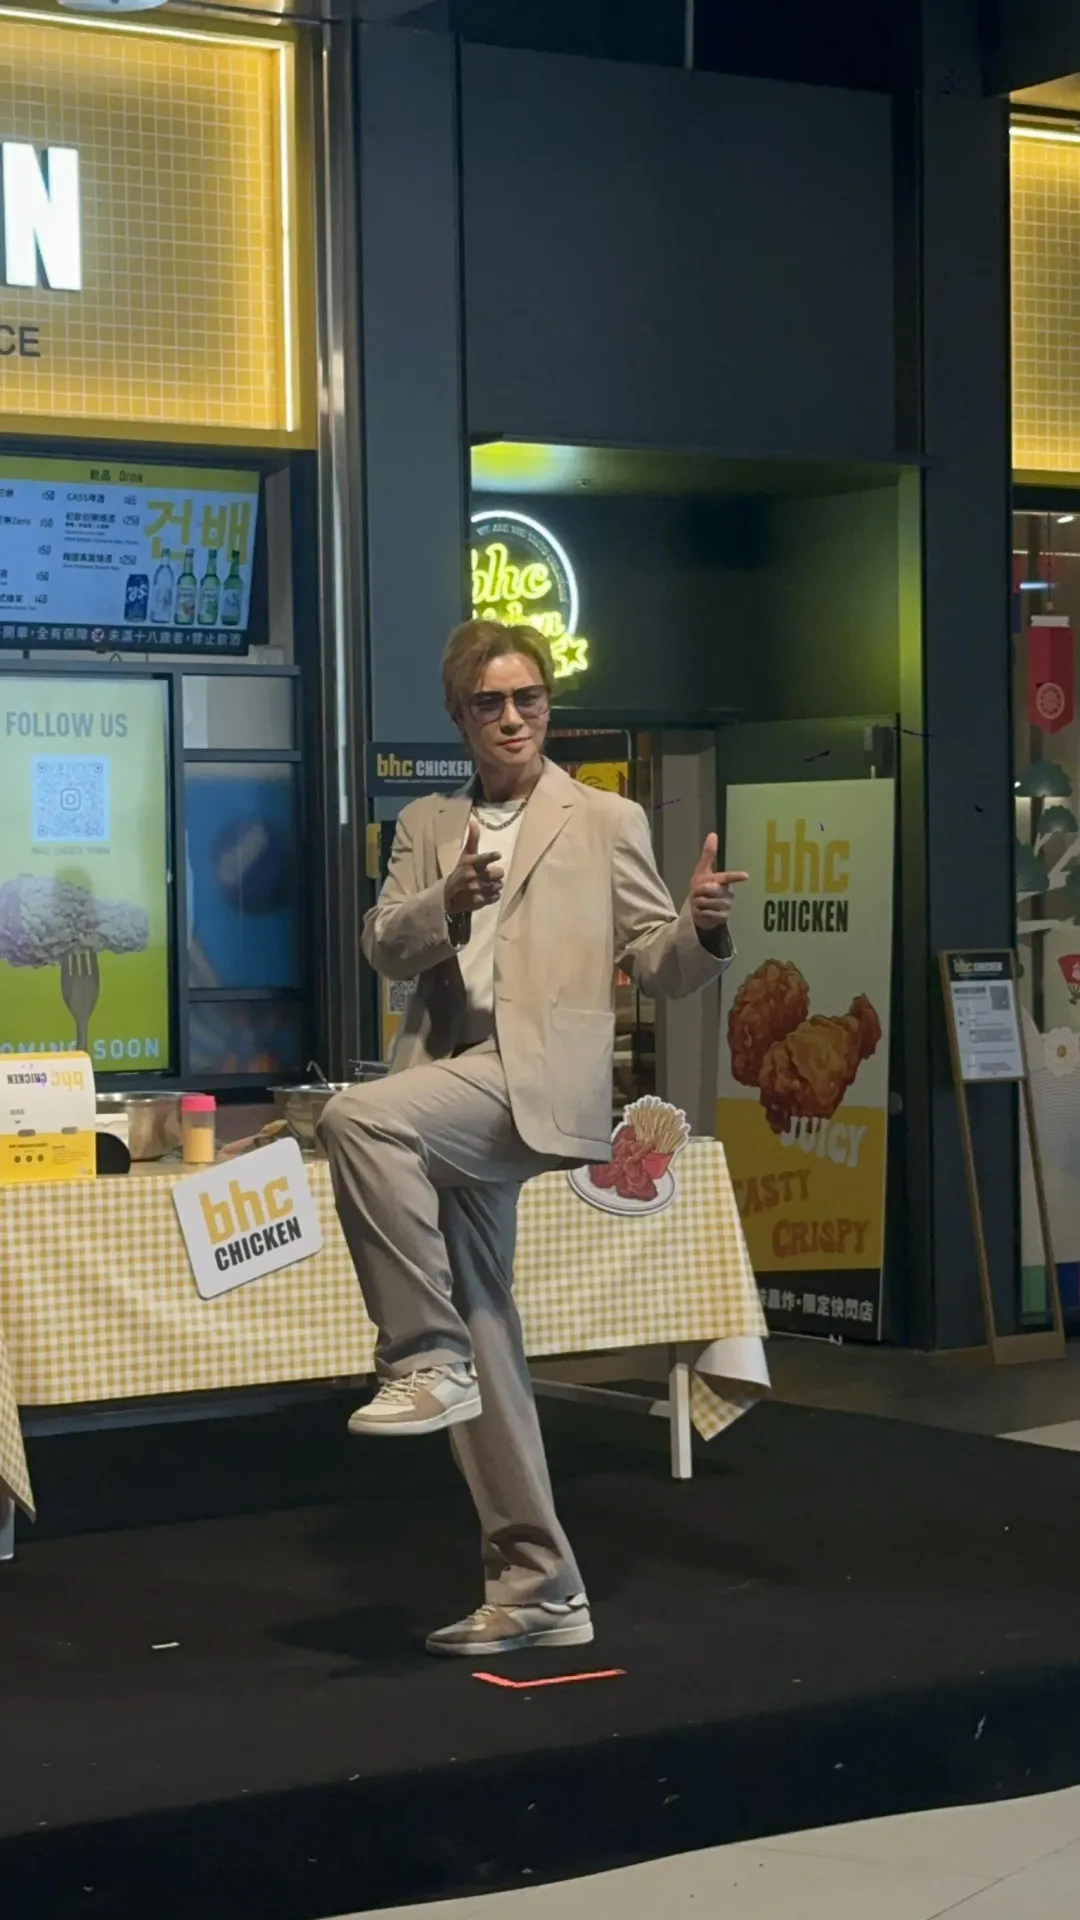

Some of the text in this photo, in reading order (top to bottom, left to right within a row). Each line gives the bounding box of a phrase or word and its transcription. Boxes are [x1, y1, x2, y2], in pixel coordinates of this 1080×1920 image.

[119, 470, 143, 483] Drink
[144, 499, 250, 566] 건배
[6, 711, 128, 739] FOLLOW US
[376, 753, 472, 777] bhc CHICKEN
[764, 818, 850, 894] bhc
[762, 900, 848, 933] CHICKEN
[94, 1037, 161, 1060] SOON
[7, 1072, 47, 1084] CHICKEN
[780, 1116, 868, 1168] JUICY
[198, 1175, 294, 1246] bhc
[214, 1216, 303, 1272] CHICKEN
[772, 1217, 870, 1259] CRISPY
